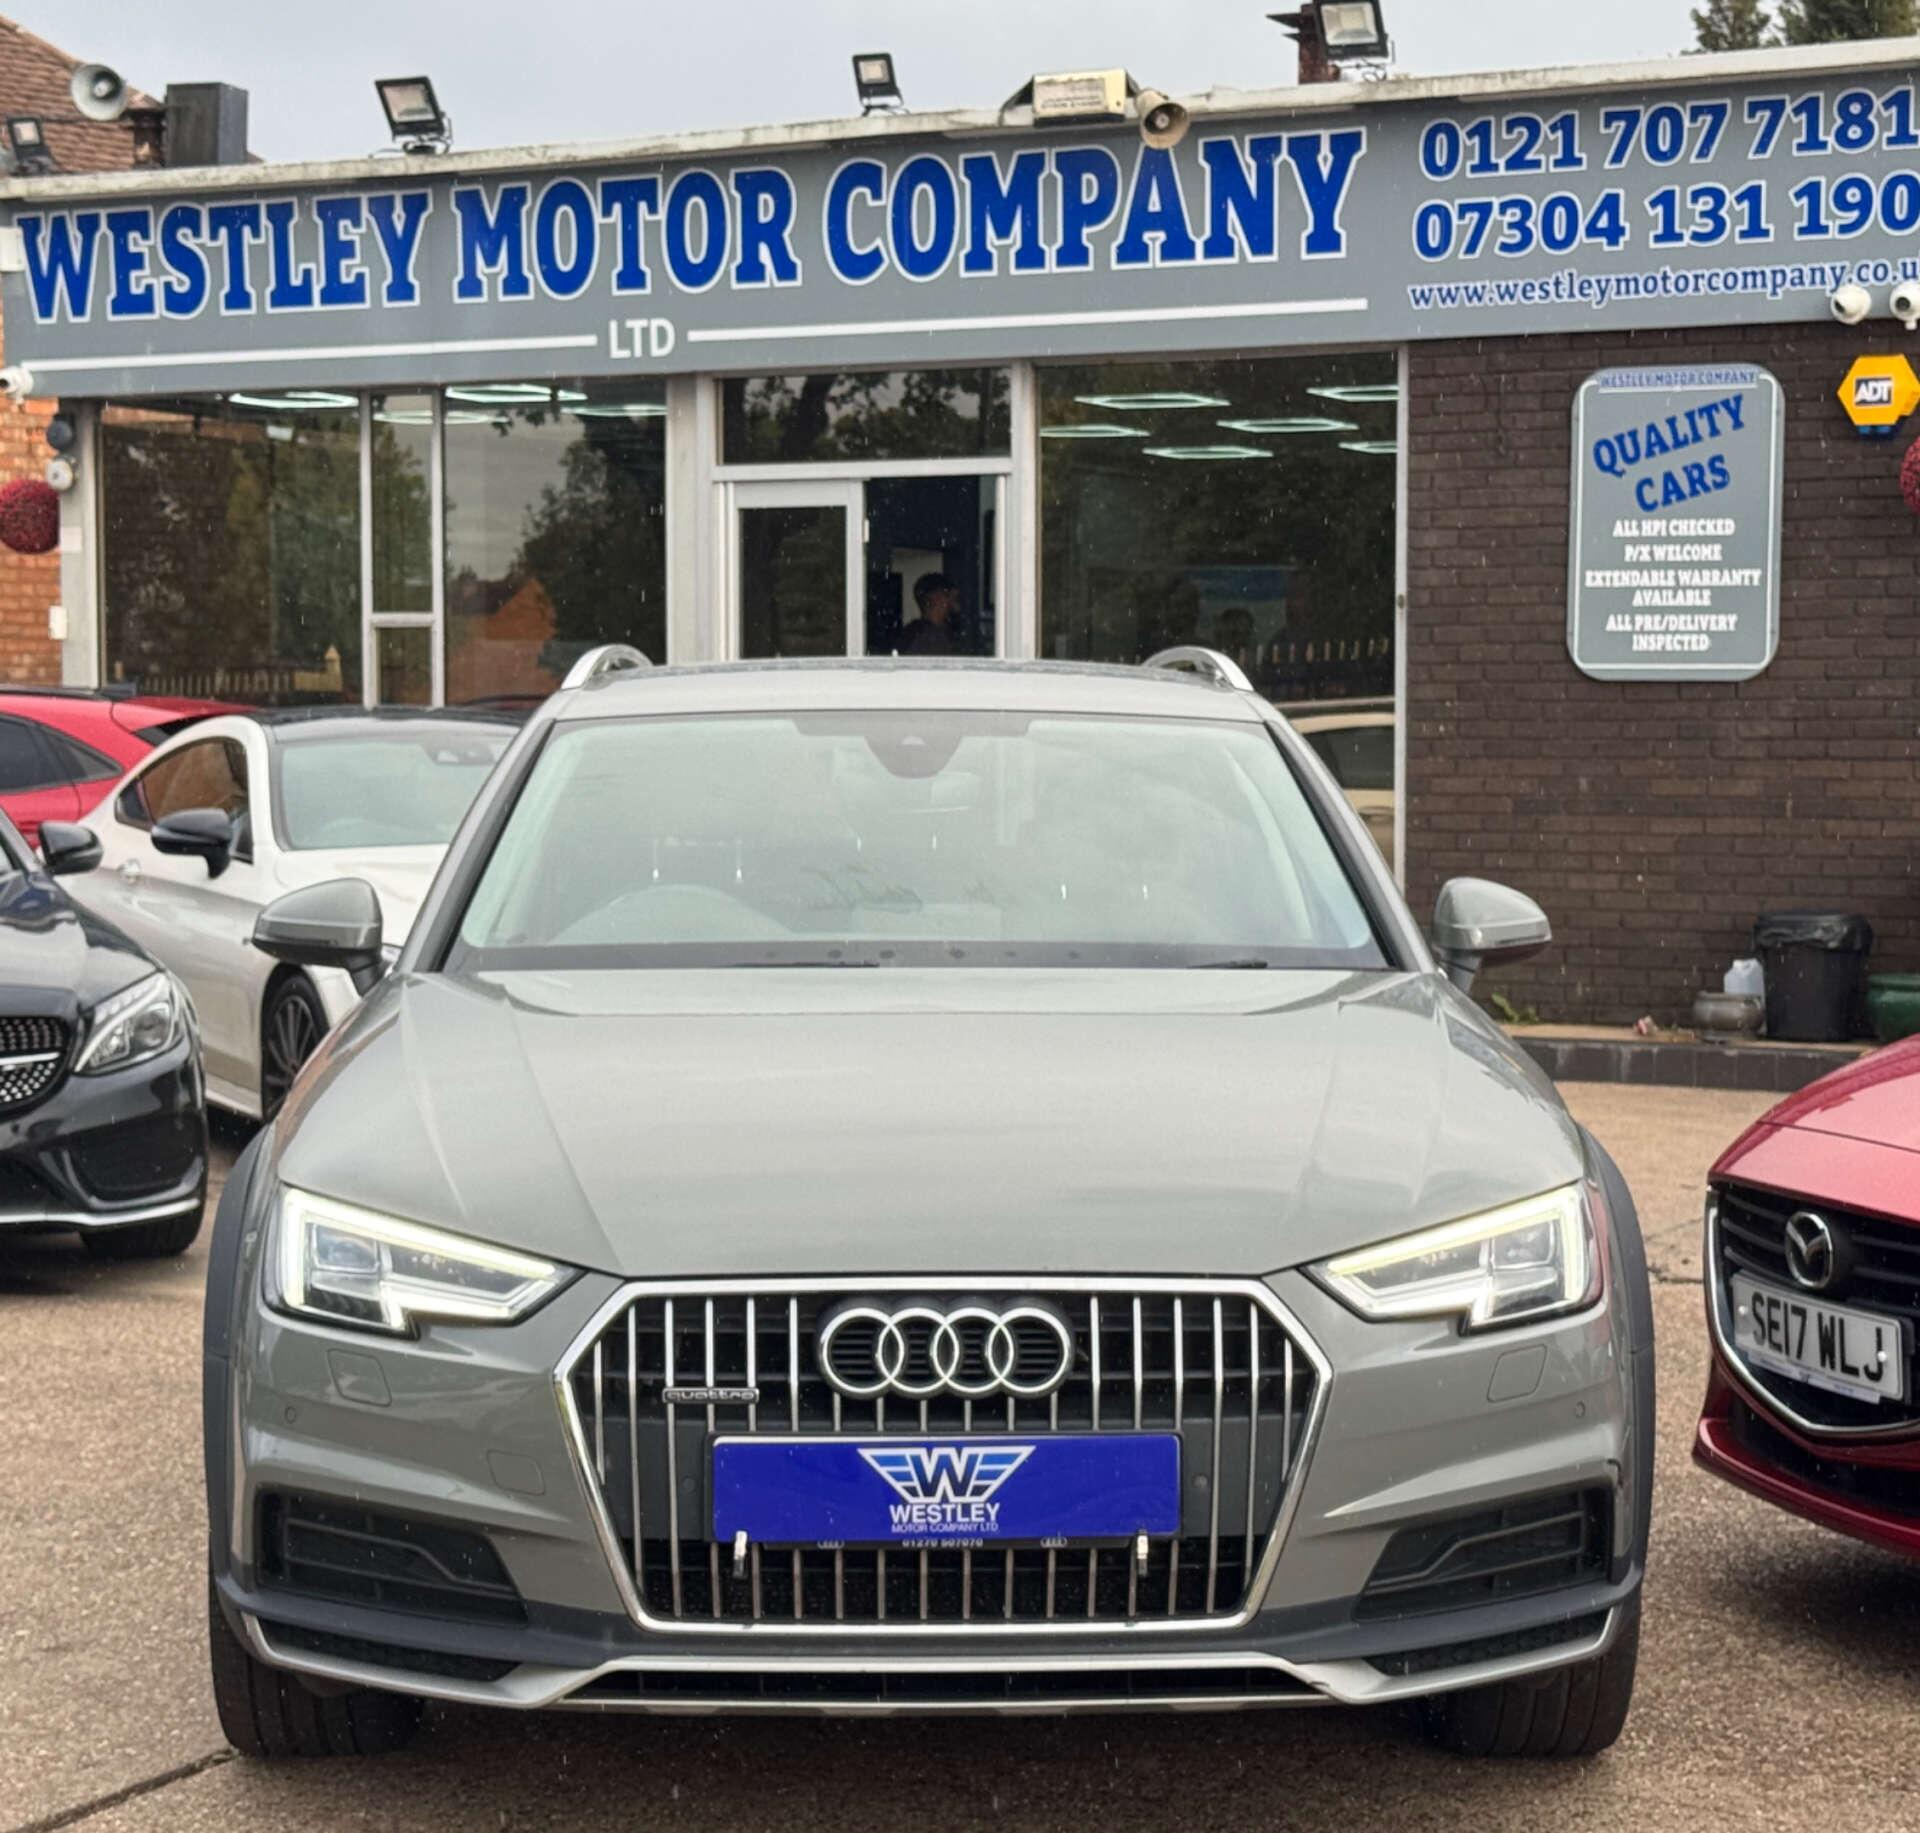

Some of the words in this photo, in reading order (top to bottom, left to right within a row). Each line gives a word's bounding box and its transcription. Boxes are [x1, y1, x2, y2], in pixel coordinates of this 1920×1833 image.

[1419, 110, 1587, 182] 0121
[1599, 101, 1731, 170] 707
[1744, 86, 1920, 159] 7181
[15, 185, 433, 325] WESTLEY
[453, 165, 802, 303] MOTOR
[822, 126, 1367, 287] COMPANY
[1412, 187, 1631, 262] 07304
[1646, 179, 1775, 249] 131
[1790, 167, 1920, 242] 190
[1407, 257, 1920, 310] www.westleymotorcompany.co.u
[609, 318, 676, 359] LTD
[1855, 380, 1893, 404] ADT
[1592, 393, 1745, 477] QUALITY
[1634, 453, 1731, 513] CARS
[1612, 519, 1640, 538] ALL
[1641, 518, 1667, 537] HPI
[1668, 518, 1736, 536] CHECKED
[1624, 544, 1651, 562] P/X
[1652, 543, 1723, 562] WELCOME
[1584, 570, 1675, 588] EXTENDABLE
[1677, 568, 1762, 587] WARRANTY
[1632, 589, 1712, 607] AVAILABLE
[1605, 614, 1633, 632] ALL
[1634, 613, 1738, 632] PRE/DELIVERY
[1632, 634, 1712, 652] INSPECTED
[1751, 1291, 1808, 1361] SE17
[1817, 1311, 1884, 1383] WLJ
[667, 1389, 755, 1401] quattro
[889, 1502, 1001, 1524] WESTLEY
[891, 1523, 928, 1534] MOTOR
[929, 1523, 978, 1533] COMPANY
[980, 1522, 1000, 1533] LTD
